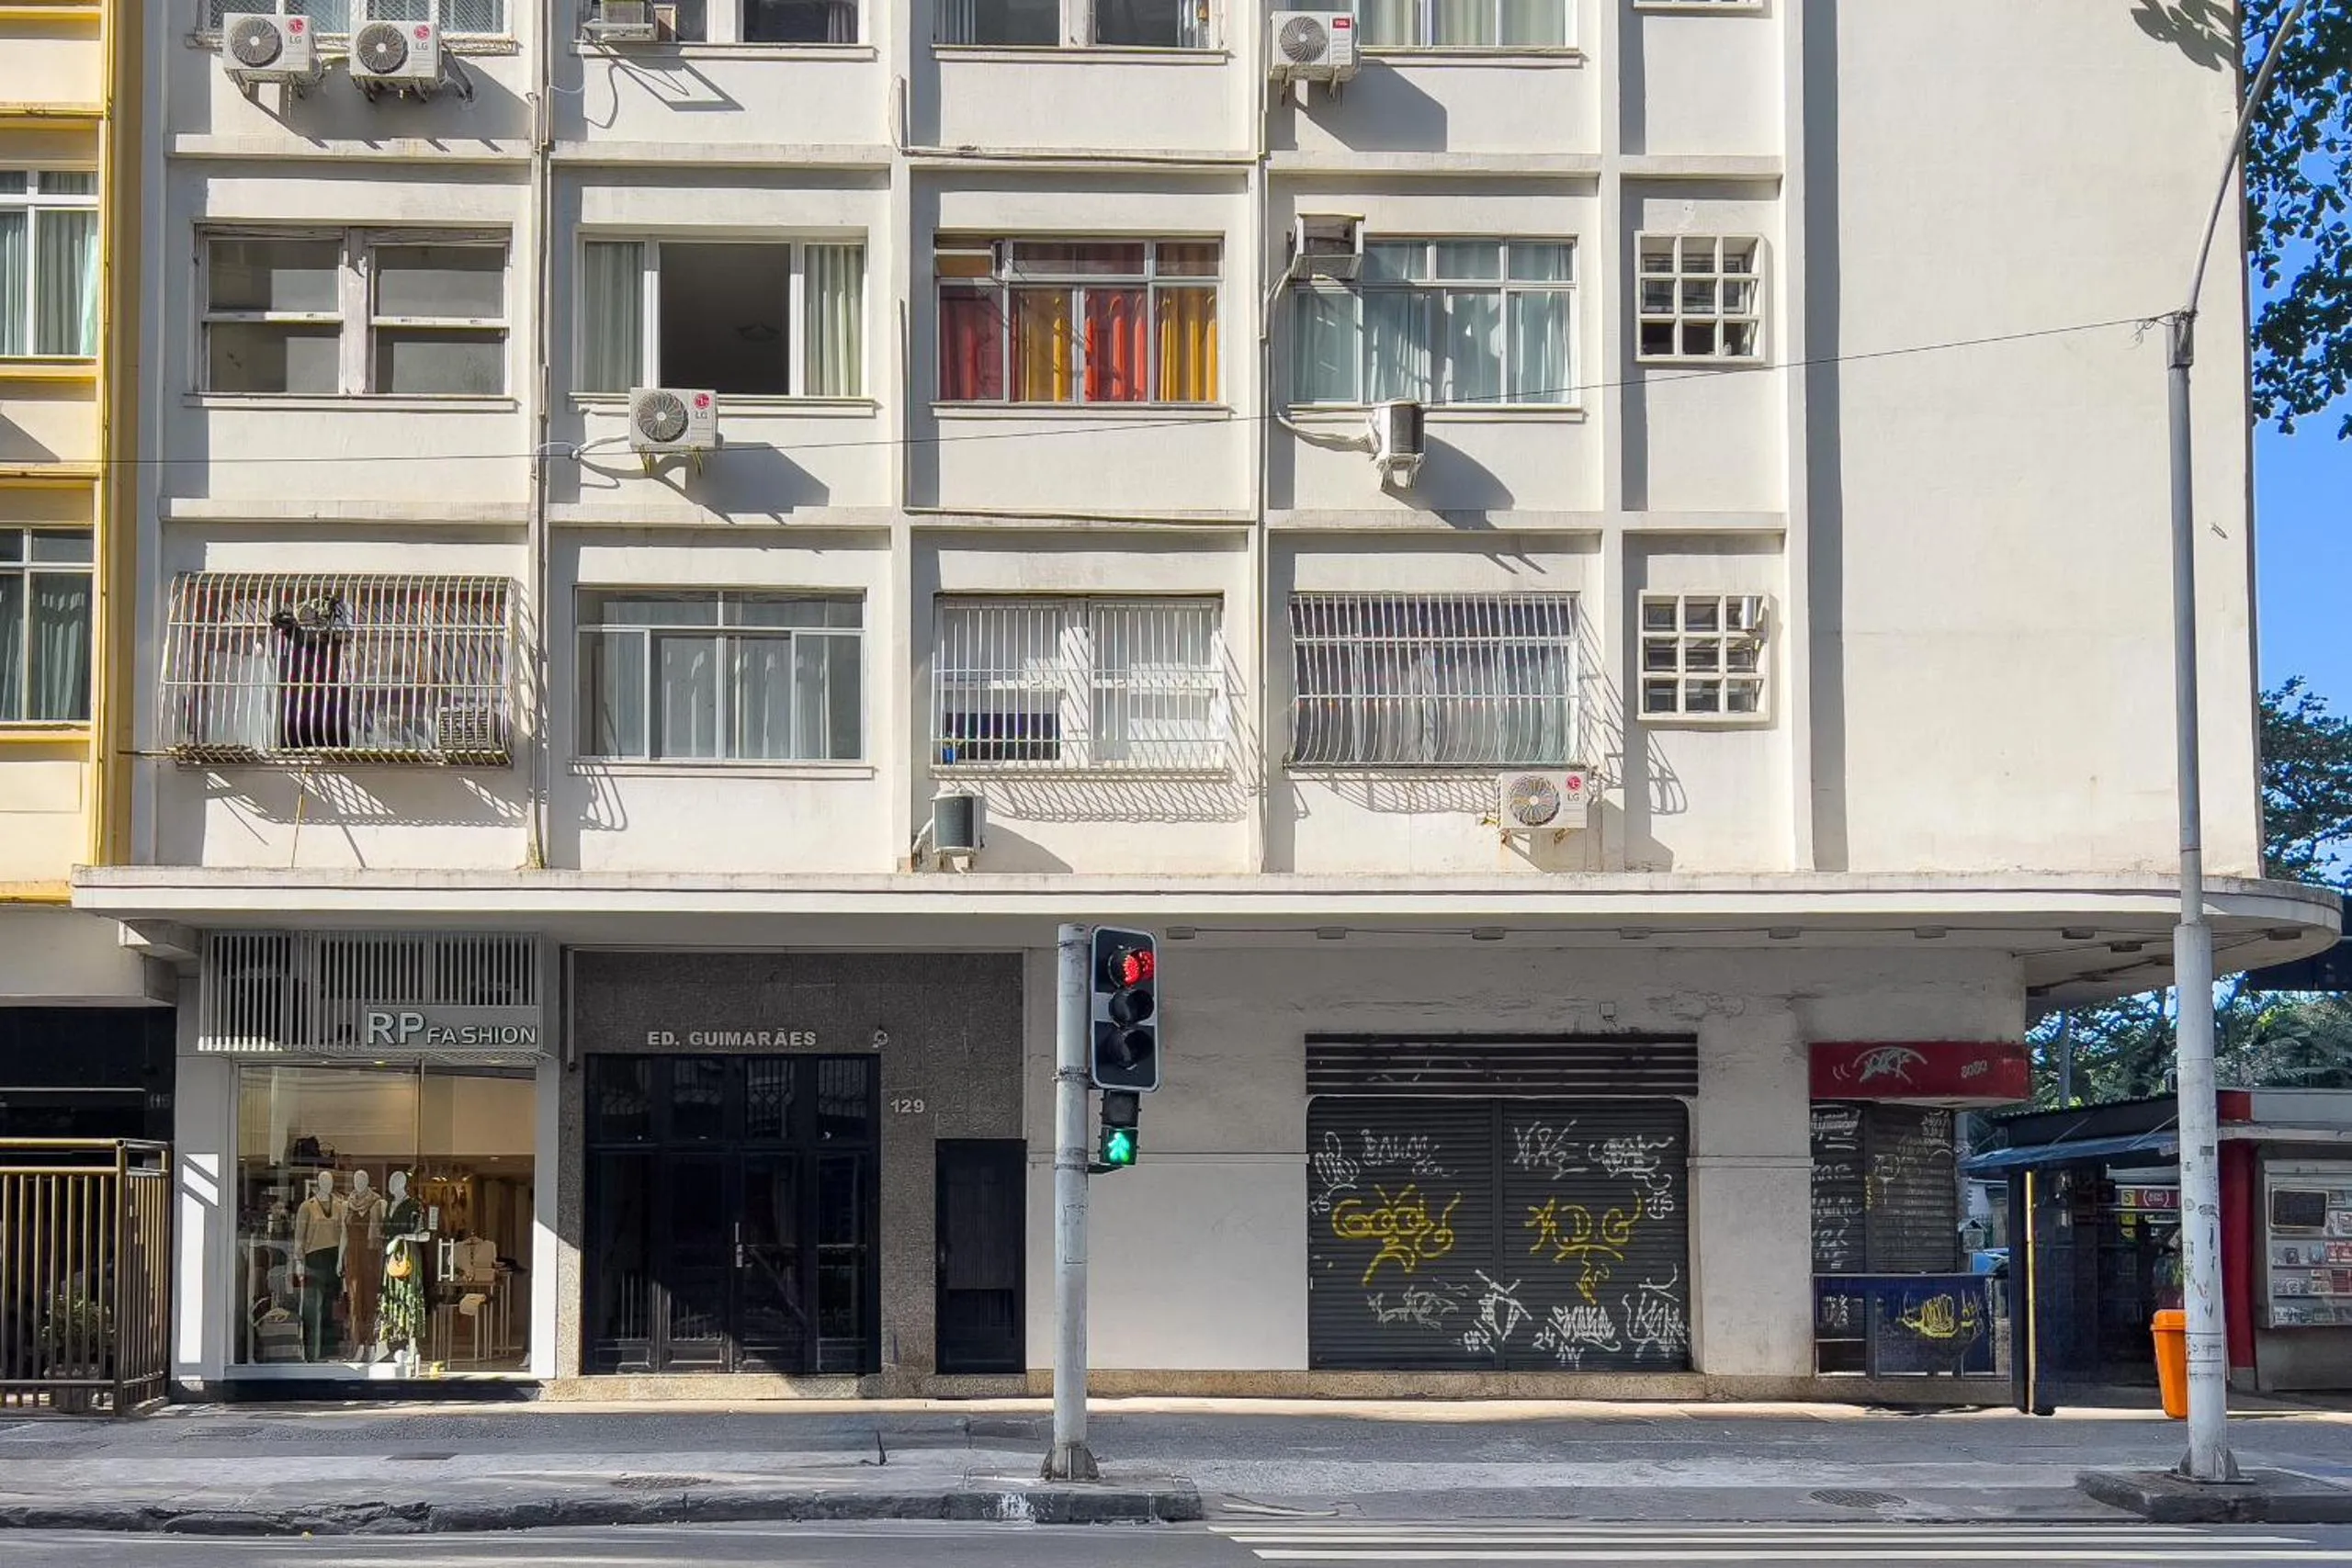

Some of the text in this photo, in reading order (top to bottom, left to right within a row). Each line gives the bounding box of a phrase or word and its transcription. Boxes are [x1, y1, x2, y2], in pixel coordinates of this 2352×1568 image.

[289, 36, 302, 44] LG
[415, 41, 428, 51] LG
[695, 410, 708, 420] LG
[1567, 793, 1580, 802] LG
[368, 1012, 537, 1044] RP FASHION
[647, 1028, 817, 1046] ED. GUIMARÃES
[890, 1099, 925, 1113] 129
